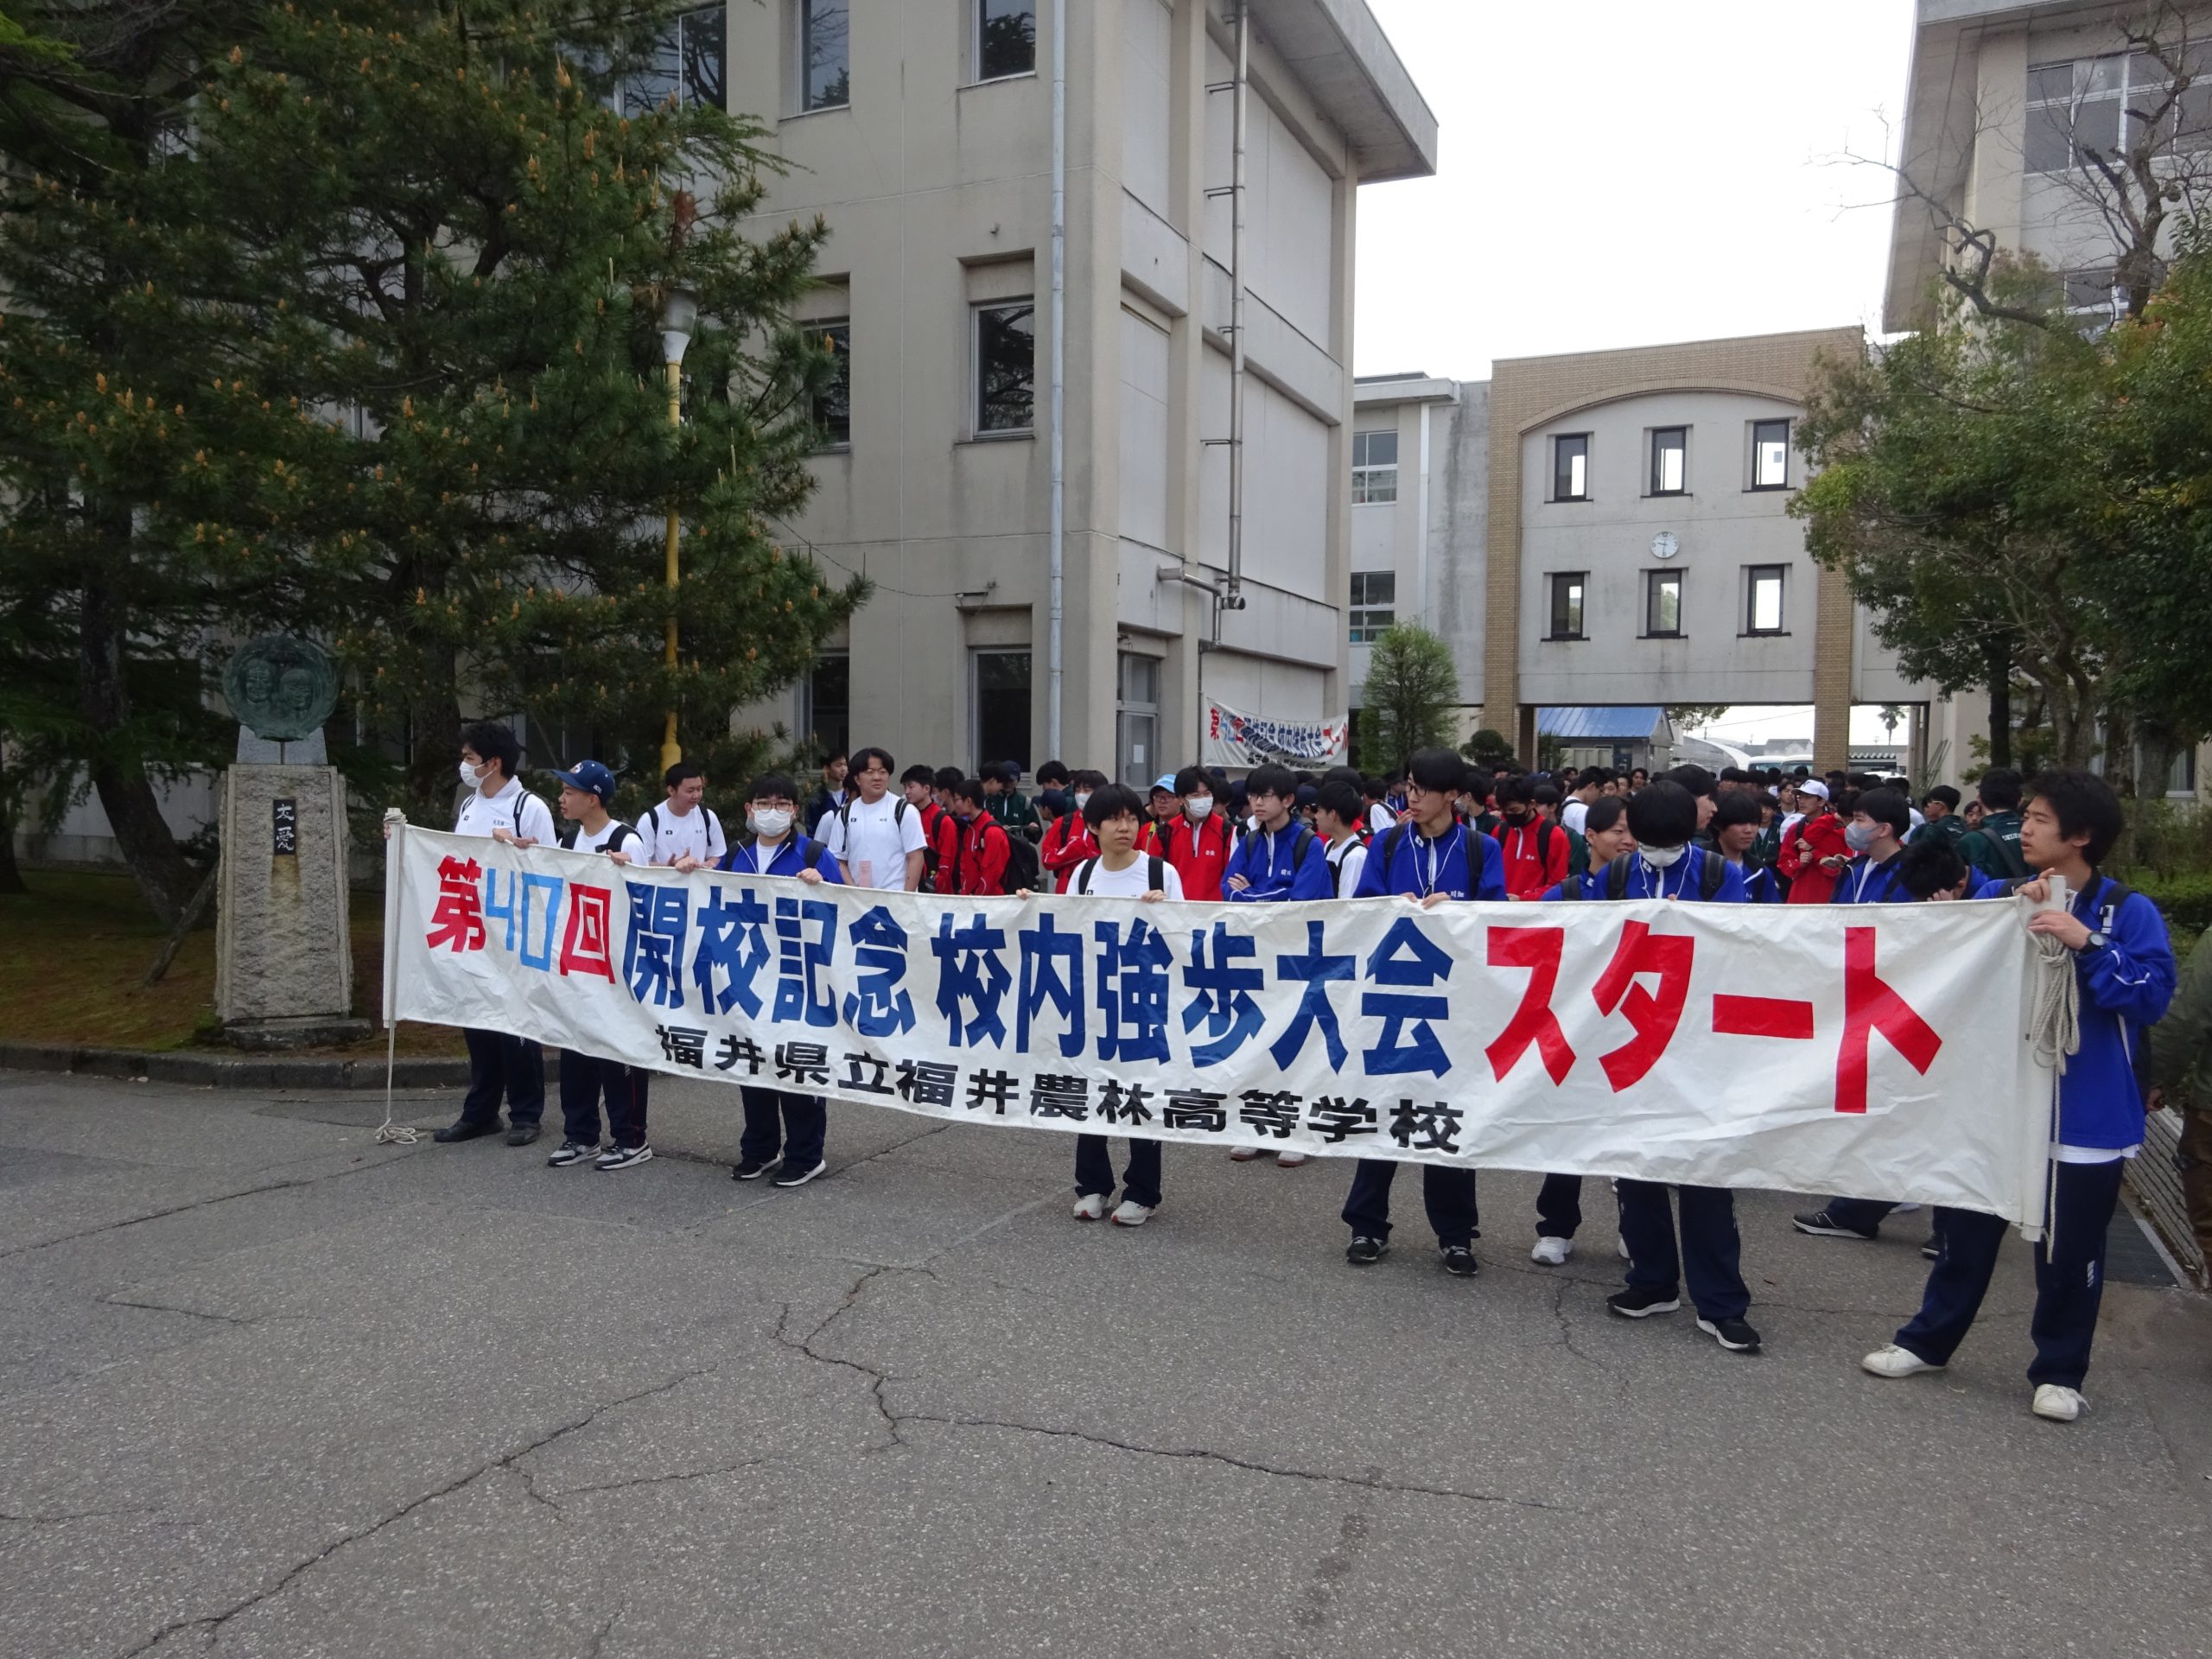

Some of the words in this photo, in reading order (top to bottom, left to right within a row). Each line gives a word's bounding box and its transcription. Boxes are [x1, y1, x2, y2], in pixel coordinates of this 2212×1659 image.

[655, 1025, 1465, 1154] 福井県立福井農林高等学校
